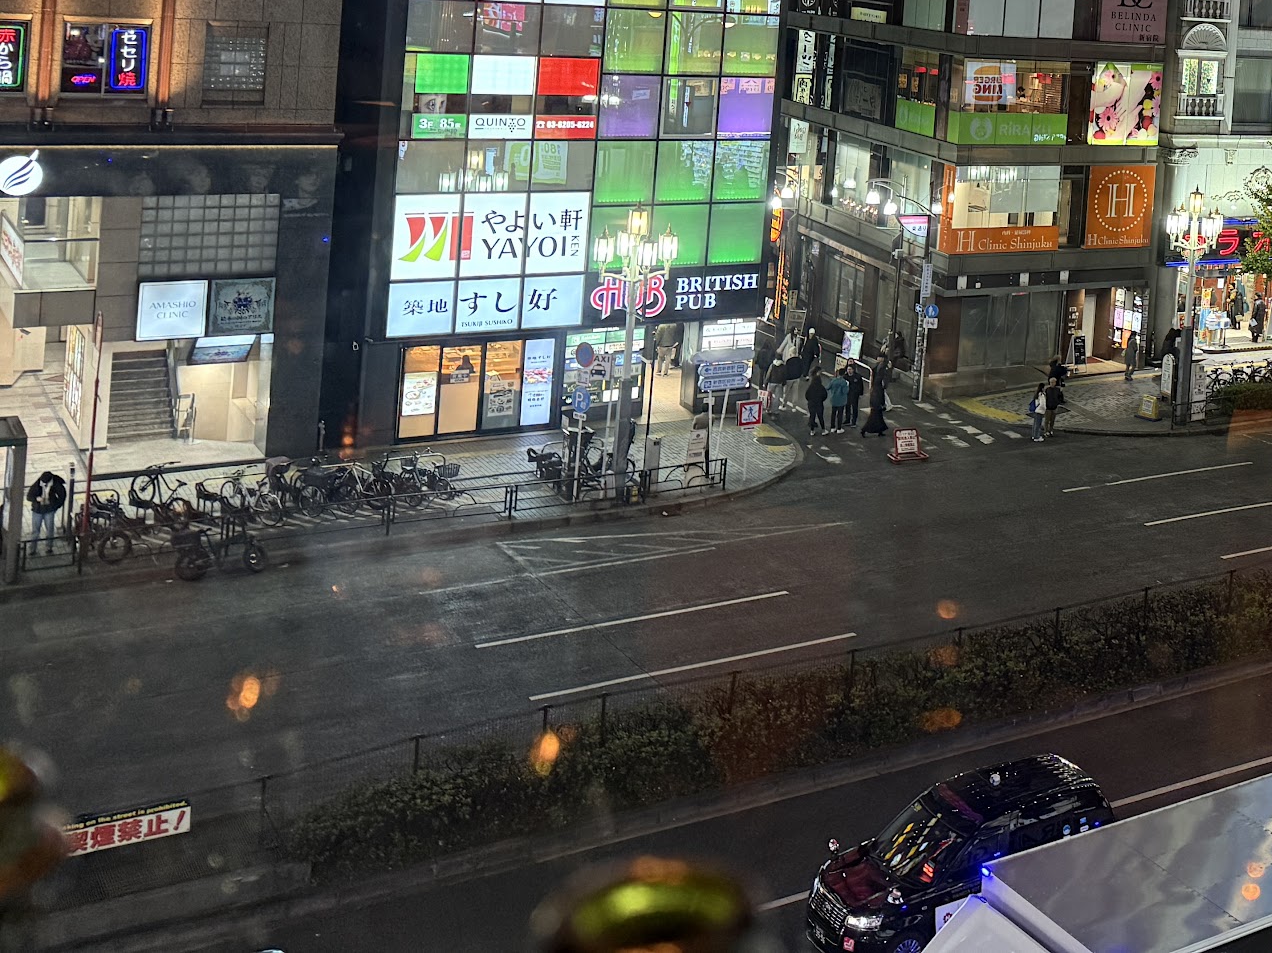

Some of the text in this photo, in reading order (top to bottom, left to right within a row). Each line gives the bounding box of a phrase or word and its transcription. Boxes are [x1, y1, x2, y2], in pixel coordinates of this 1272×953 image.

[1111, 10, 1157, 22] BELINDA
[1115, 22, 1151, 33] CLINIC
[1139, 34, 1160, 43] 新宿院
[419, 118, 434, 129] 3F
[1105, 183, 1138, 219] H
[481, 208, 583, 233] やよい軒
[482, 235, 567, 260] YAYOI
[570, 235, 580, 258] KEN
[955, 230, 1053, 252] H Clinic Shinjuku
[1098, 235, 1119, 245] Clinic
[676, 273, 759, 293] BRITISH
[149, 299, 197, 311] AMASHIO
[402, 299, 449, 316] 築地
[675, 293, 717, 311] PUB
[156, 309, 190, 320] CLINIC
